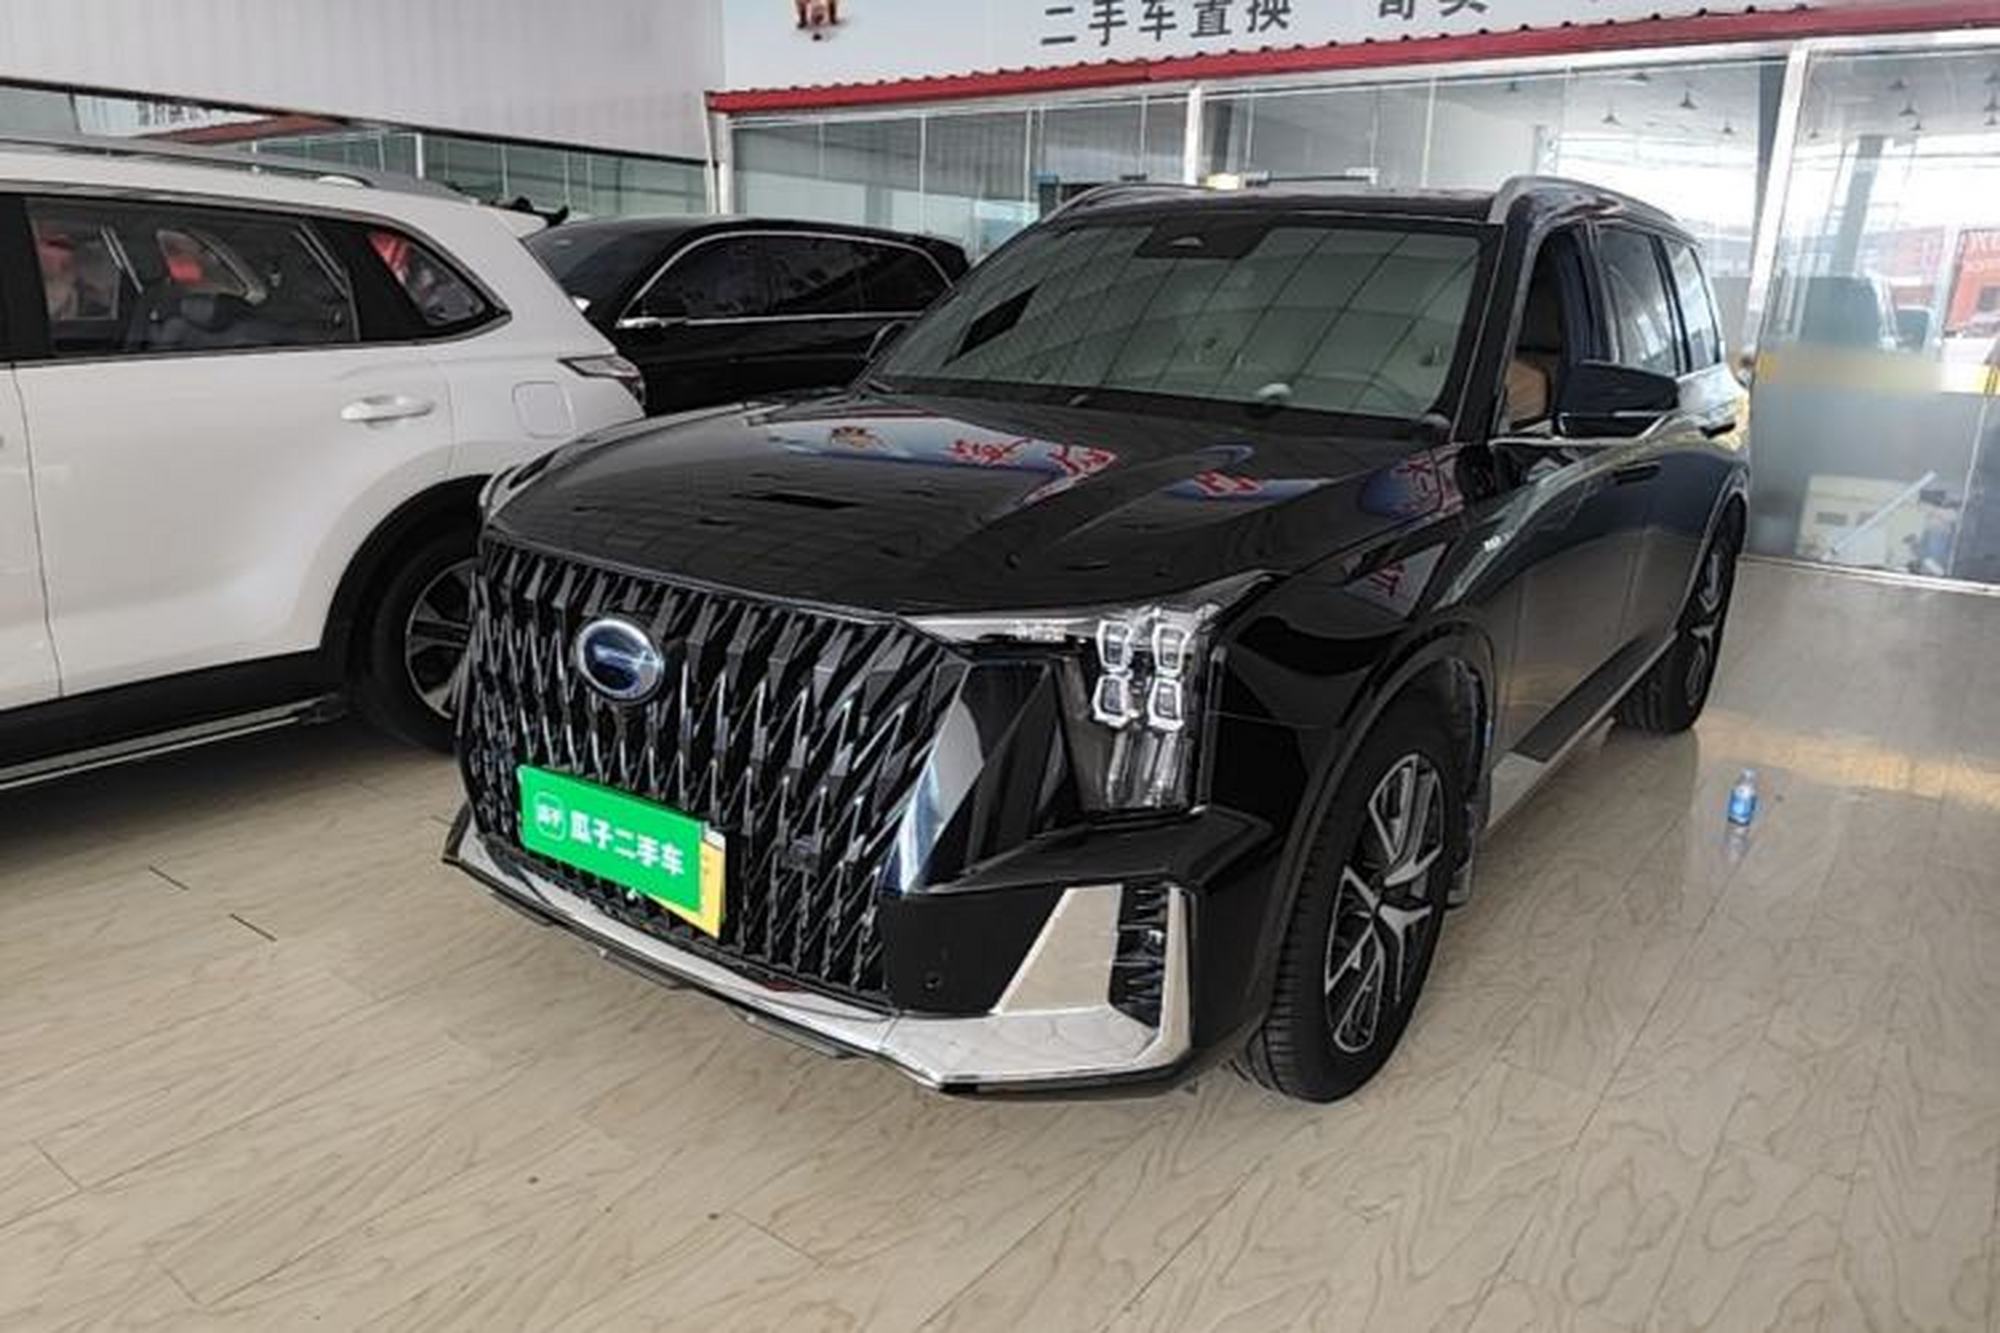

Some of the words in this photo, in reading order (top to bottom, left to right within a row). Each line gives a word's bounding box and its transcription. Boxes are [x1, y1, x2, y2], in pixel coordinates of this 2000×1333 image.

[1040, 0, 1291, 46] 二手车置换
